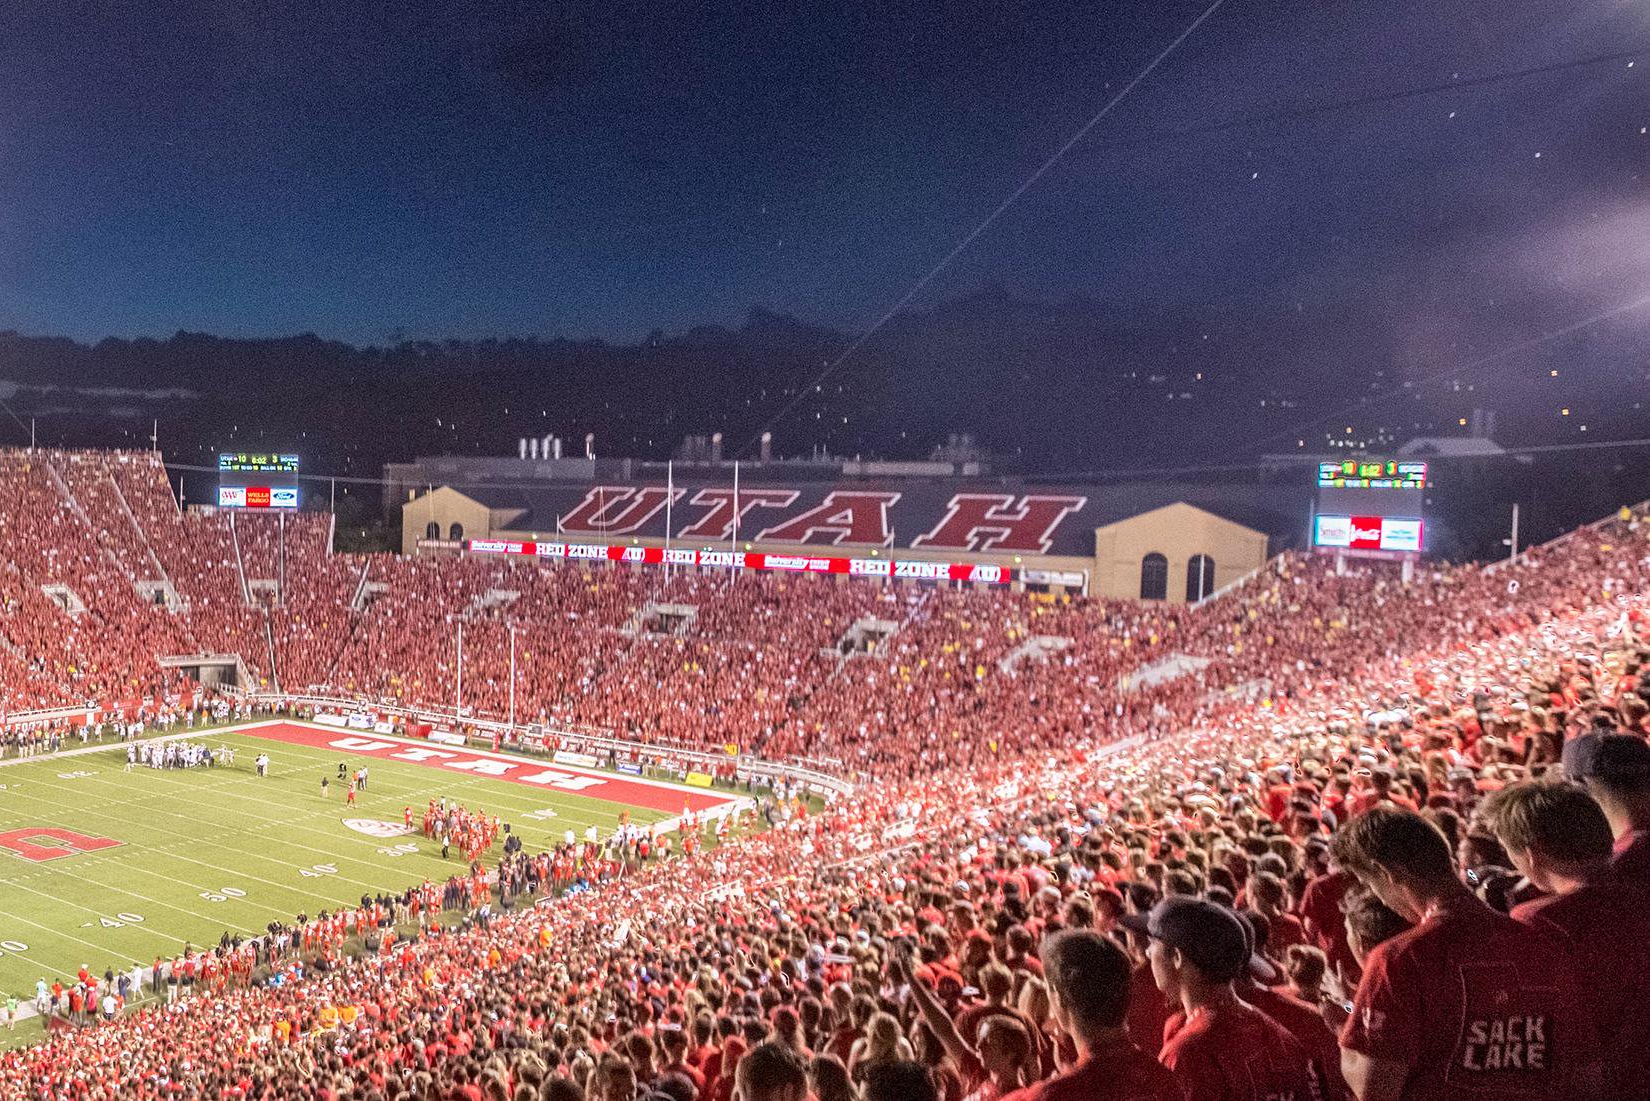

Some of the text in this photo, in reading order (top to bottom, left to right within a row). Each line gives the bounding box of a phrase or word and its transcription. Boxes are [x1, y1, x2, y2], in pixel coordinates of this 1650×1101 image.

[558, 486, 1088, 553] UTAH
[536, 543, 566, 557] RED
[568, 543, 609, 559] ZONE
[662, 549, 746, 566] RED ZONE
[849, 559, 890, 575] RED
[894, 561, 950, 579] ZONE
[328, 737, 609, 790] UTAH
[298, 863, 340, 878] 40
[198, 886, 248, 902] 50
[98, 911, 146, 929] 40
[1466, 1014, 1545, 1046] SACK
[1462, 1043, 1546, 1072] LAKE
